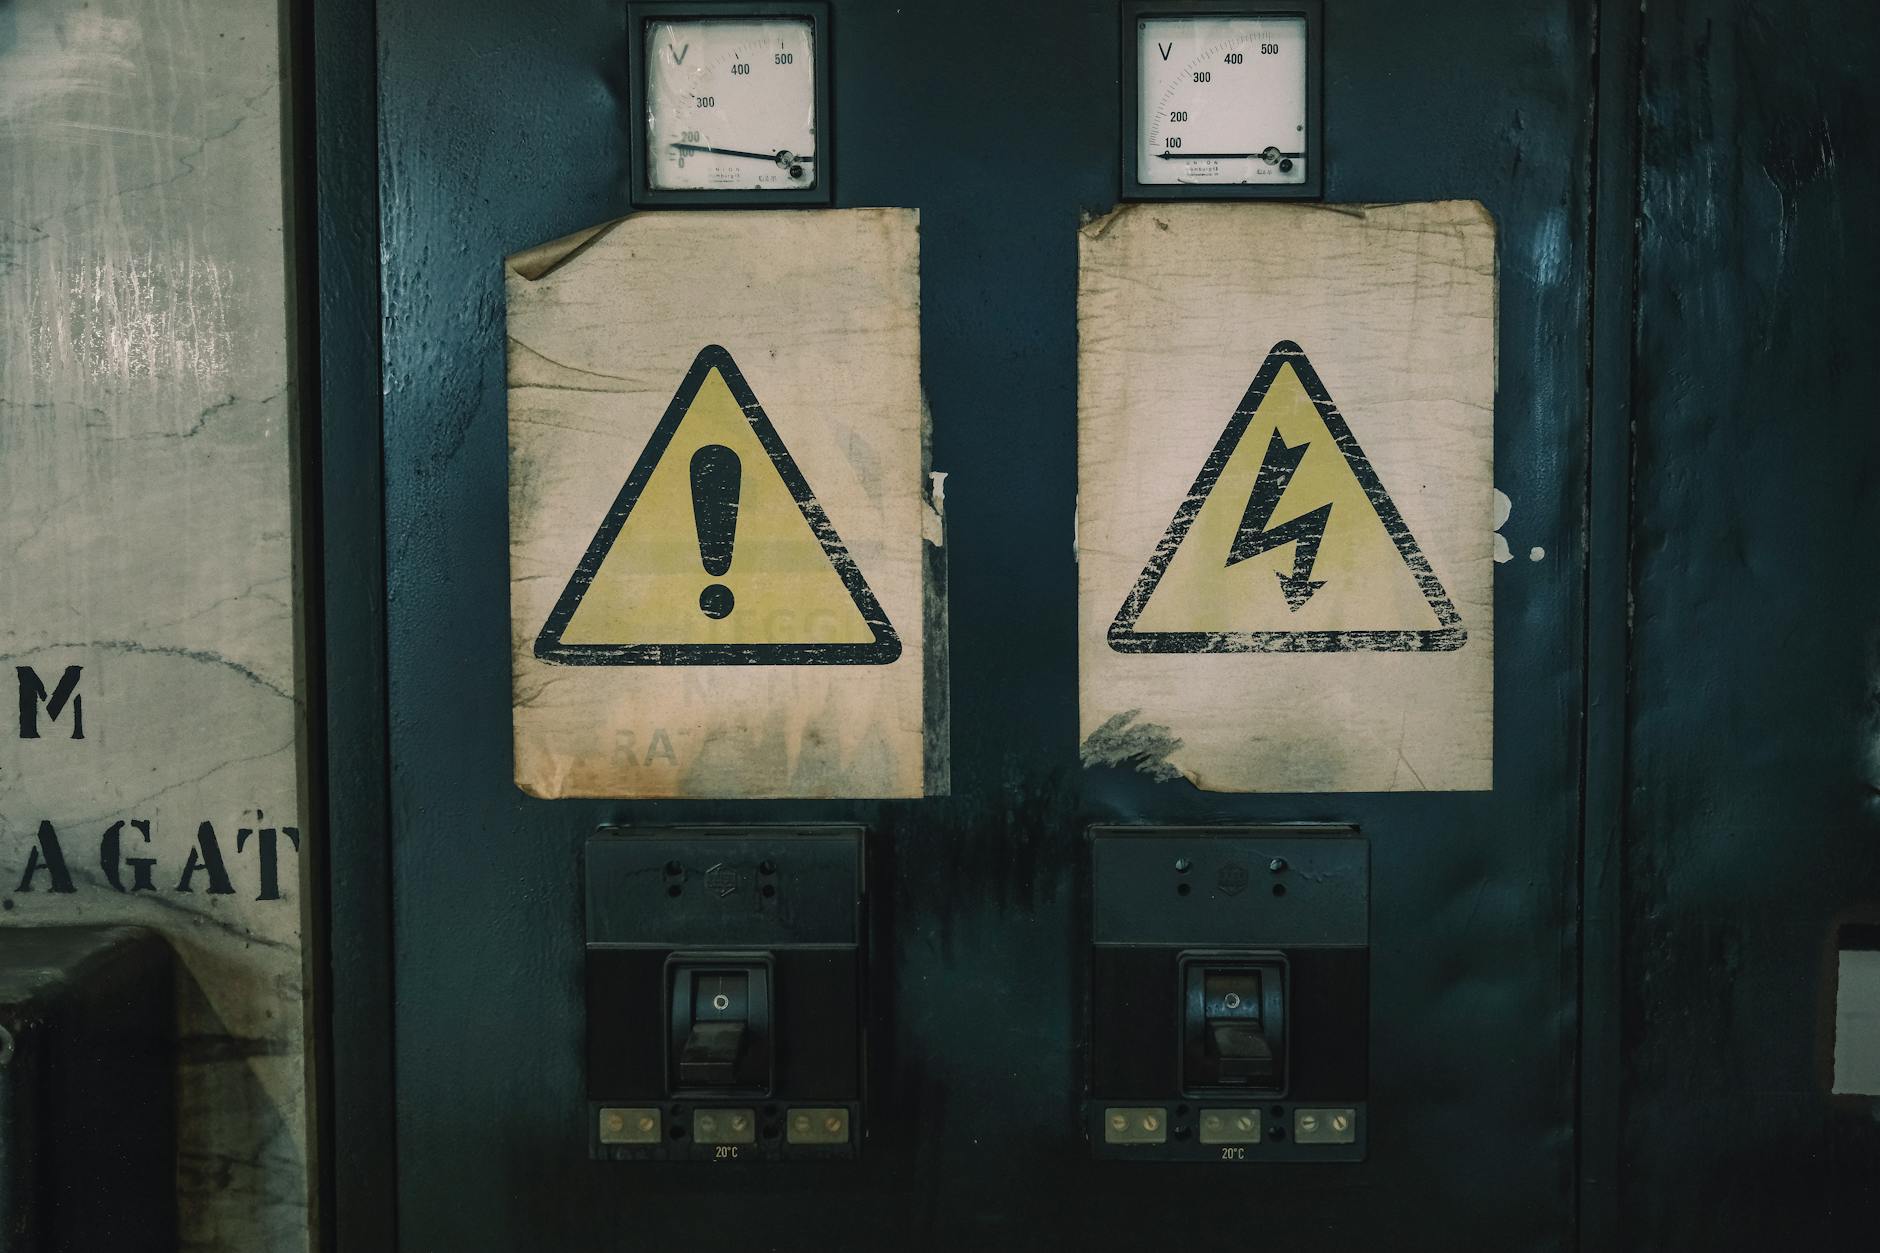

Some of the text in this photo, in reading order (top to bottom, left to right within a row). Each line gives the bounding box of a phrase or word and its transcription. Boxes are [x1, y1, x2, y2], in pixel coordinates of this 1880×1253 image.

[669, 44, 689, 65] V
[1159, 42, 1172, 61] V
[1261, 44, 1279, 55] 500
[774, 53, 793, 65] 500
[1224, 53, 1243, 65] 400
[731, 63, 750, 75] 400
[1193, 72, 1211, 83] 300
[696, 96, 715, 108] 300
[1170, 111, 1188, 122] 200
[681, 131, 700, 143] 200
[1165, 137, 1182, 149] 100
[16, 664, 85, 739] M
[15, 819, 299, 901] AGAT
[716, 1145, 738, 1158] 20°C
[1222, 1147, 1244, 1159] 20°C
